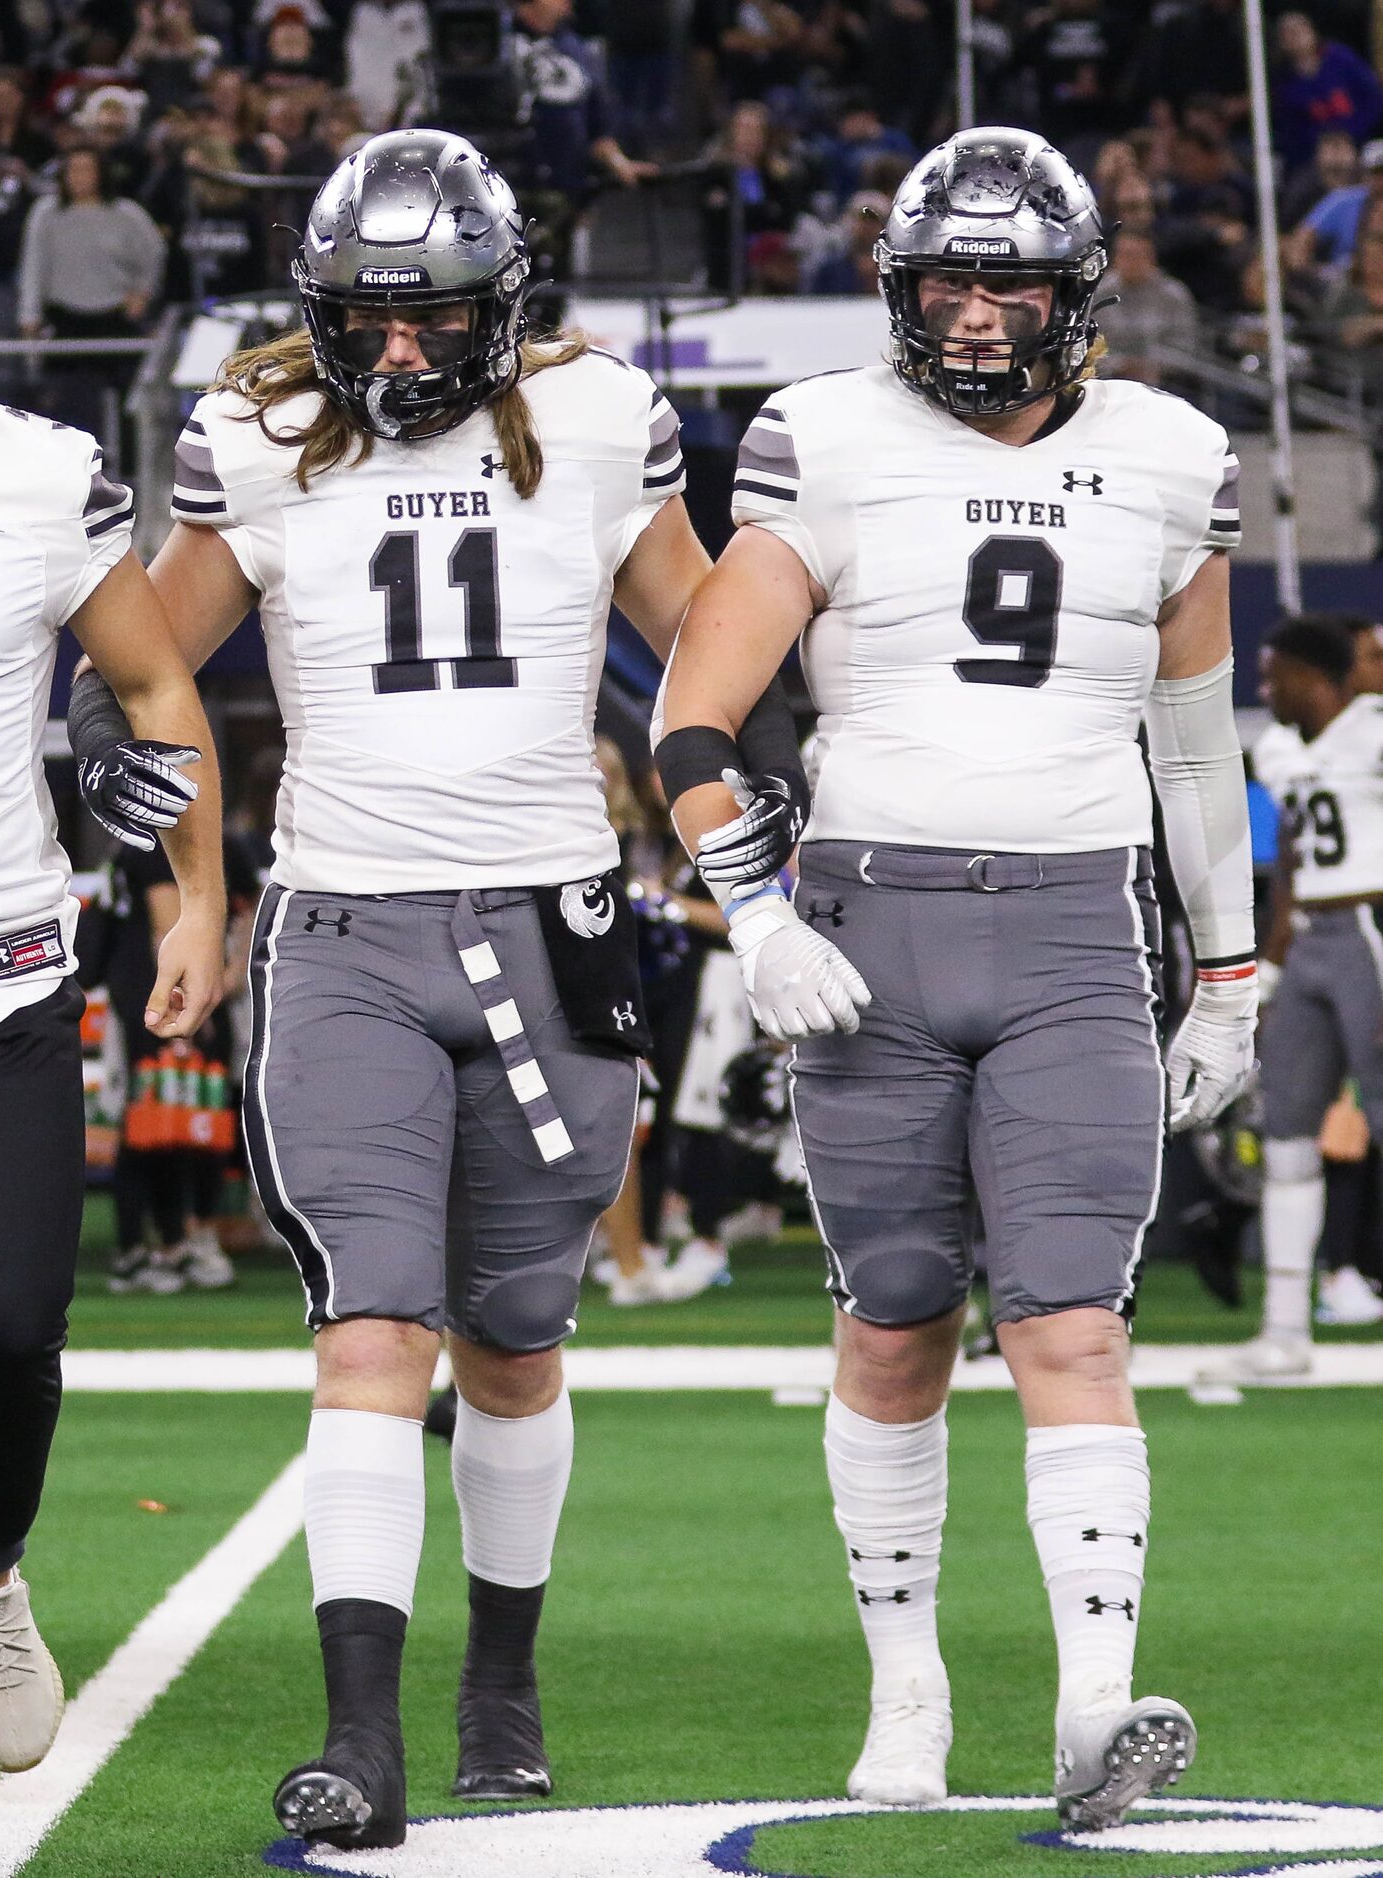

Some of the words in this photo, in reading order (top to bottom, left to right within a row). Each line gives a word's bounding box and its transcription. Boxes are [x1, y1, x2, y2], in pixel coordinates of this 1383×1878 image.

[951, 240, 1011, 255] Riddell
[361, 271, 420, 284] Riddell
[387, 491, 491, 520] GUYER
[966, 499, 1066, 528] GUYER
[368, 527, 519, 694] 11
[953, 534, 1065, 689] 9
